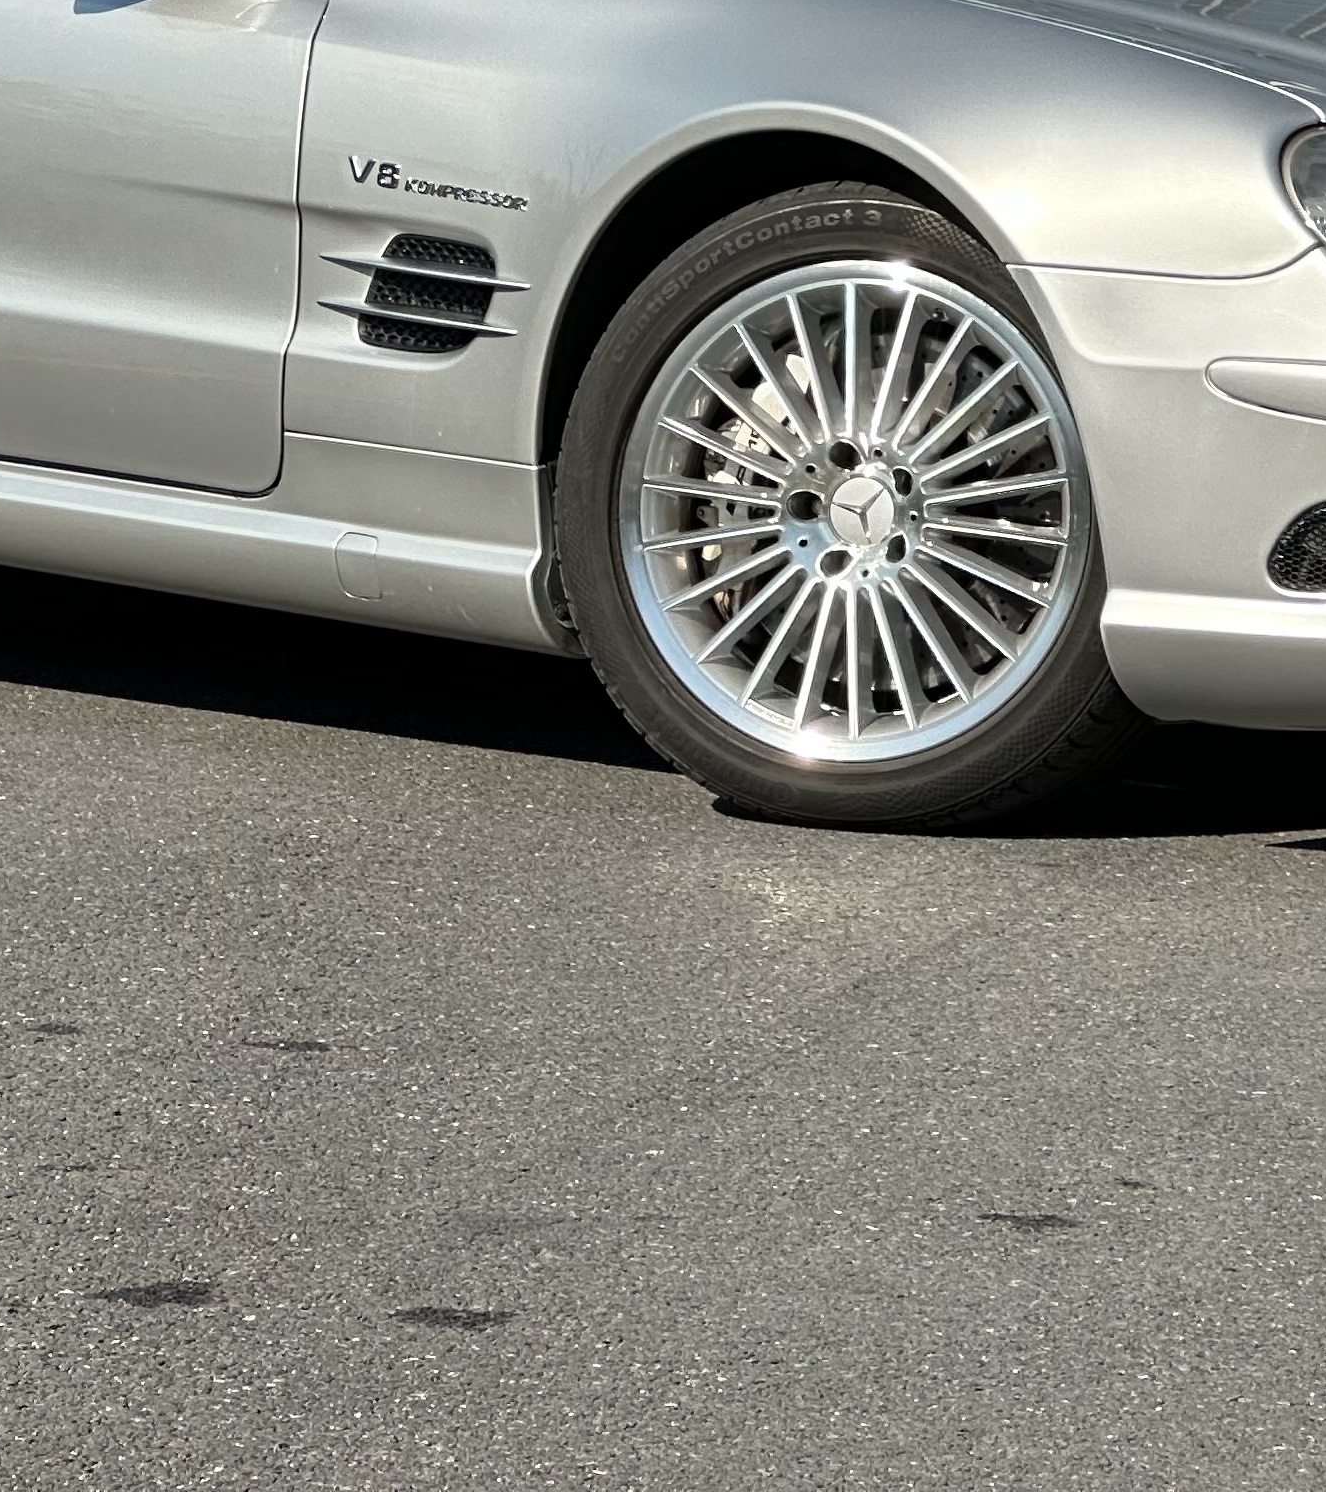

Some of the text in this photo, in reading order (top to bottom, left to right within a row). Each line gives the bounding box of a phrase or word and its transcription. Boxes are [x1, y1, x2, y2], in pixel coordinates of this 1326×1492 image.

[348, 155, 530, 212] V8 KOMPRESSOR
[611, 207, 883, 365] ContiSportContact 3
